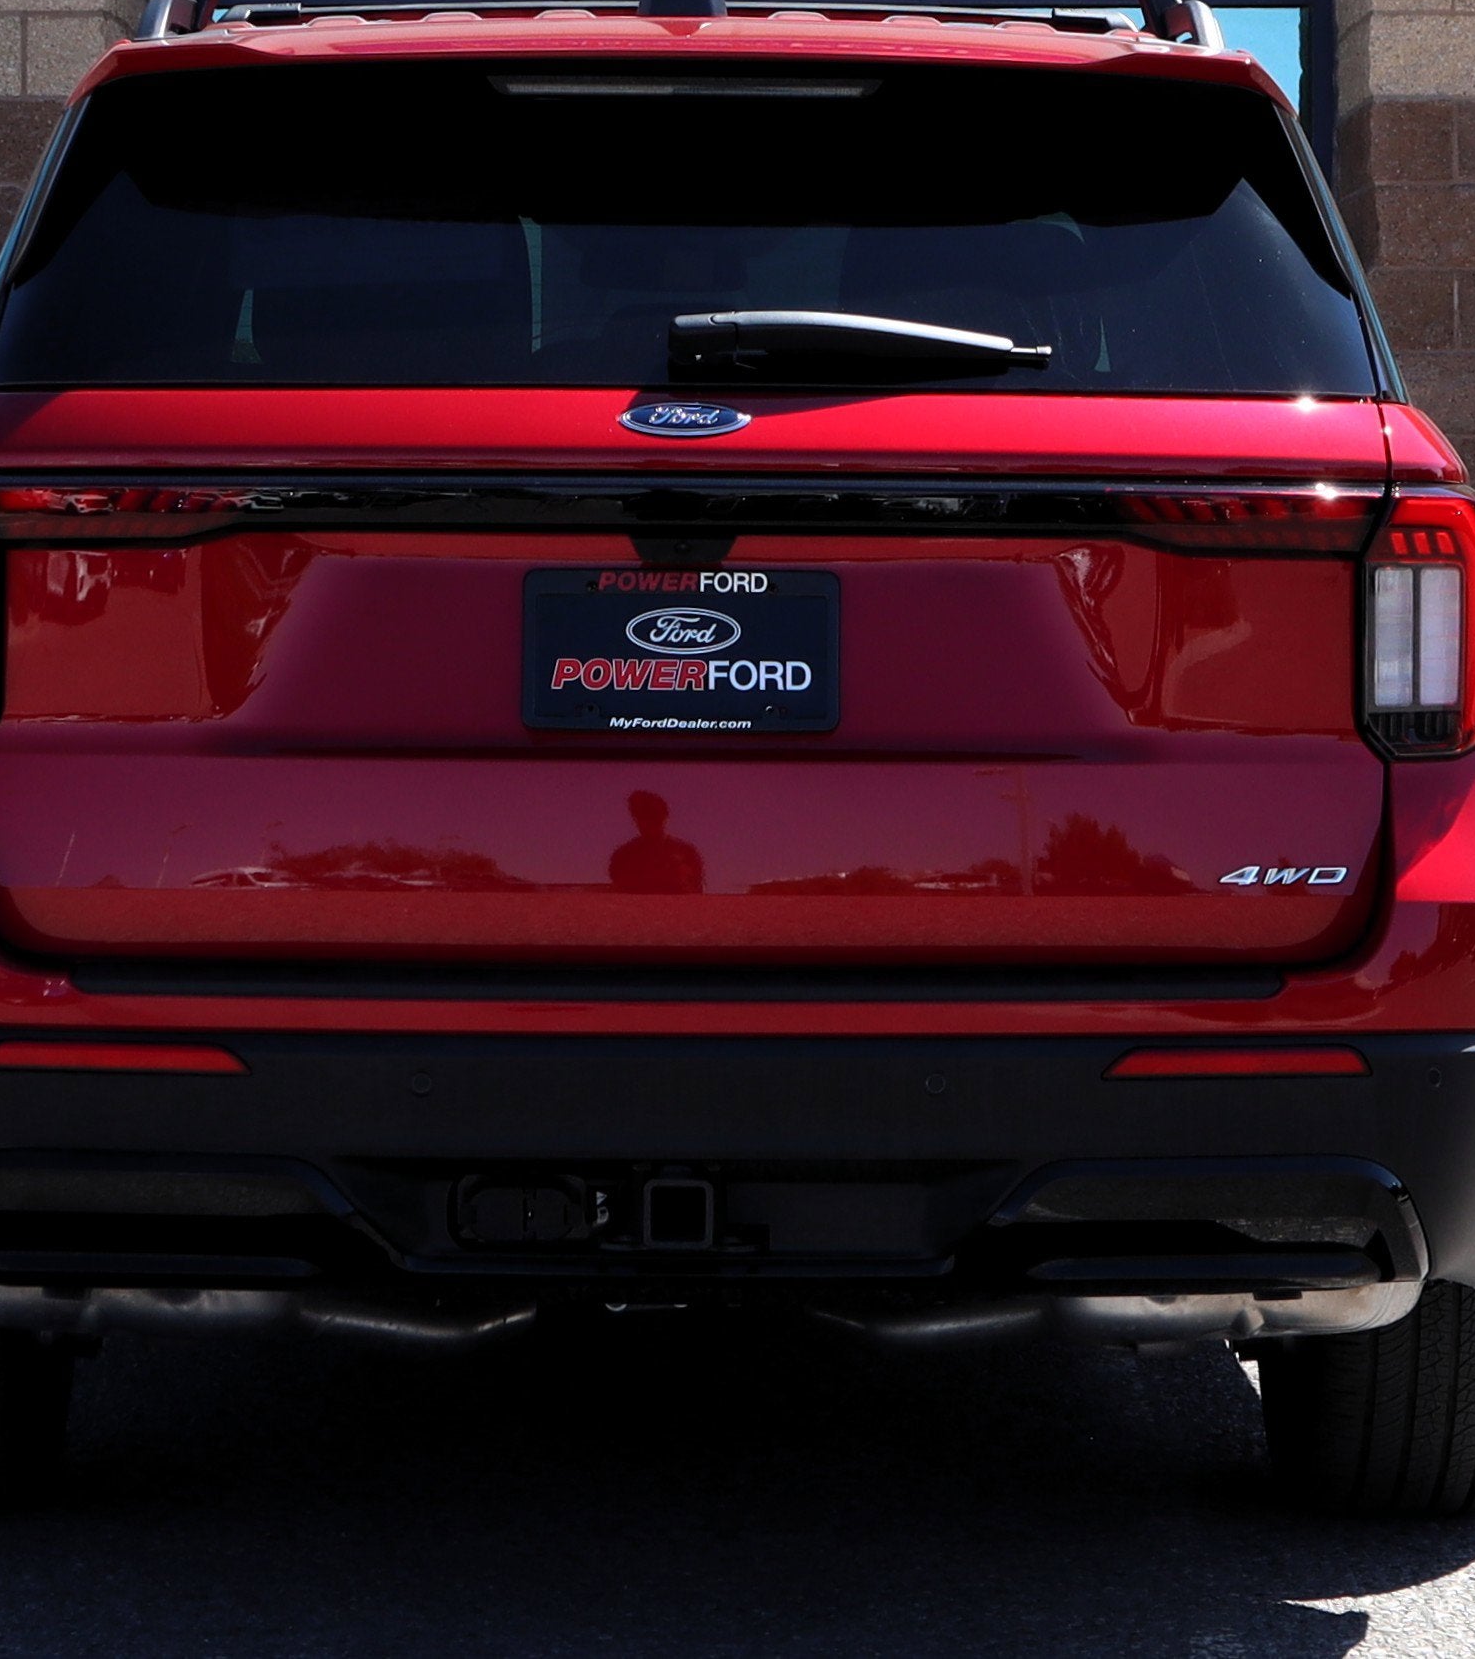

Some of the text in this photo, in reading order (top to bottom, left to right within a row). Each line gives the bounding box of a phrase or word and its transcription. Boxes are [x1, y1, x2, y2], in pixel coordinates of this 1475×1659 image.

[649, 406, 720, 425] Ford
[650, 615, 716, 644] Ford
[609, 716, 752, 730] MyFordDealer.com
[1219, 865, 1347, 885] 4WD
